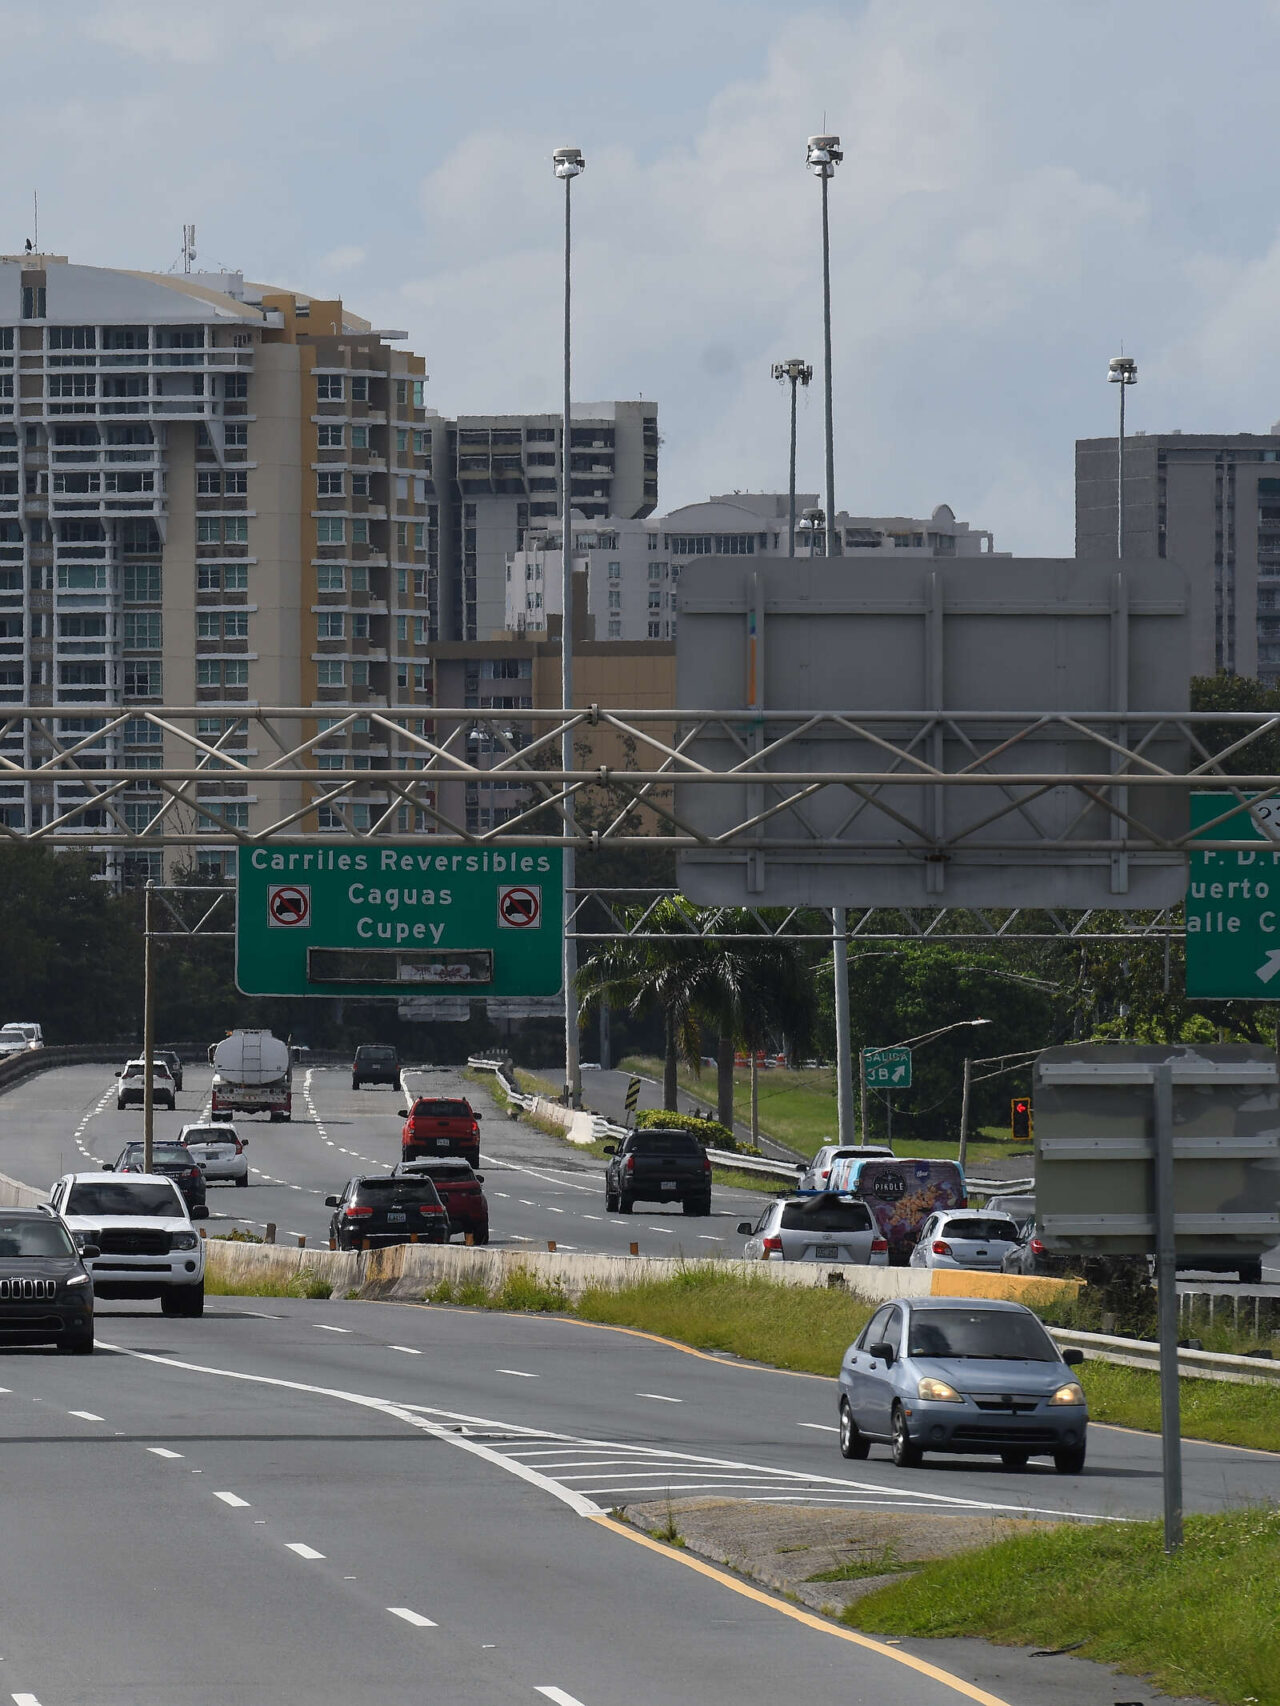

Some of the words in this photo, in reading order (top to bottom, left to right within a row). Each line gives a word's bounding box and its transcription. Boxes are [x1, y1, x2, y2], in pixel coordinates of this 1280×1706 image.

[251, 848, 368, 871] Carriles
[380, 849, 551, 872] Reversibles
[348, 882, 453, 912] Caguas
[1191, 878, 1269, 898] uerto
[356, 917, 445, 944] Cupey
[1186, 911, 1241, 933] alle
[866, 1052, 909, 1062] SALIDA
